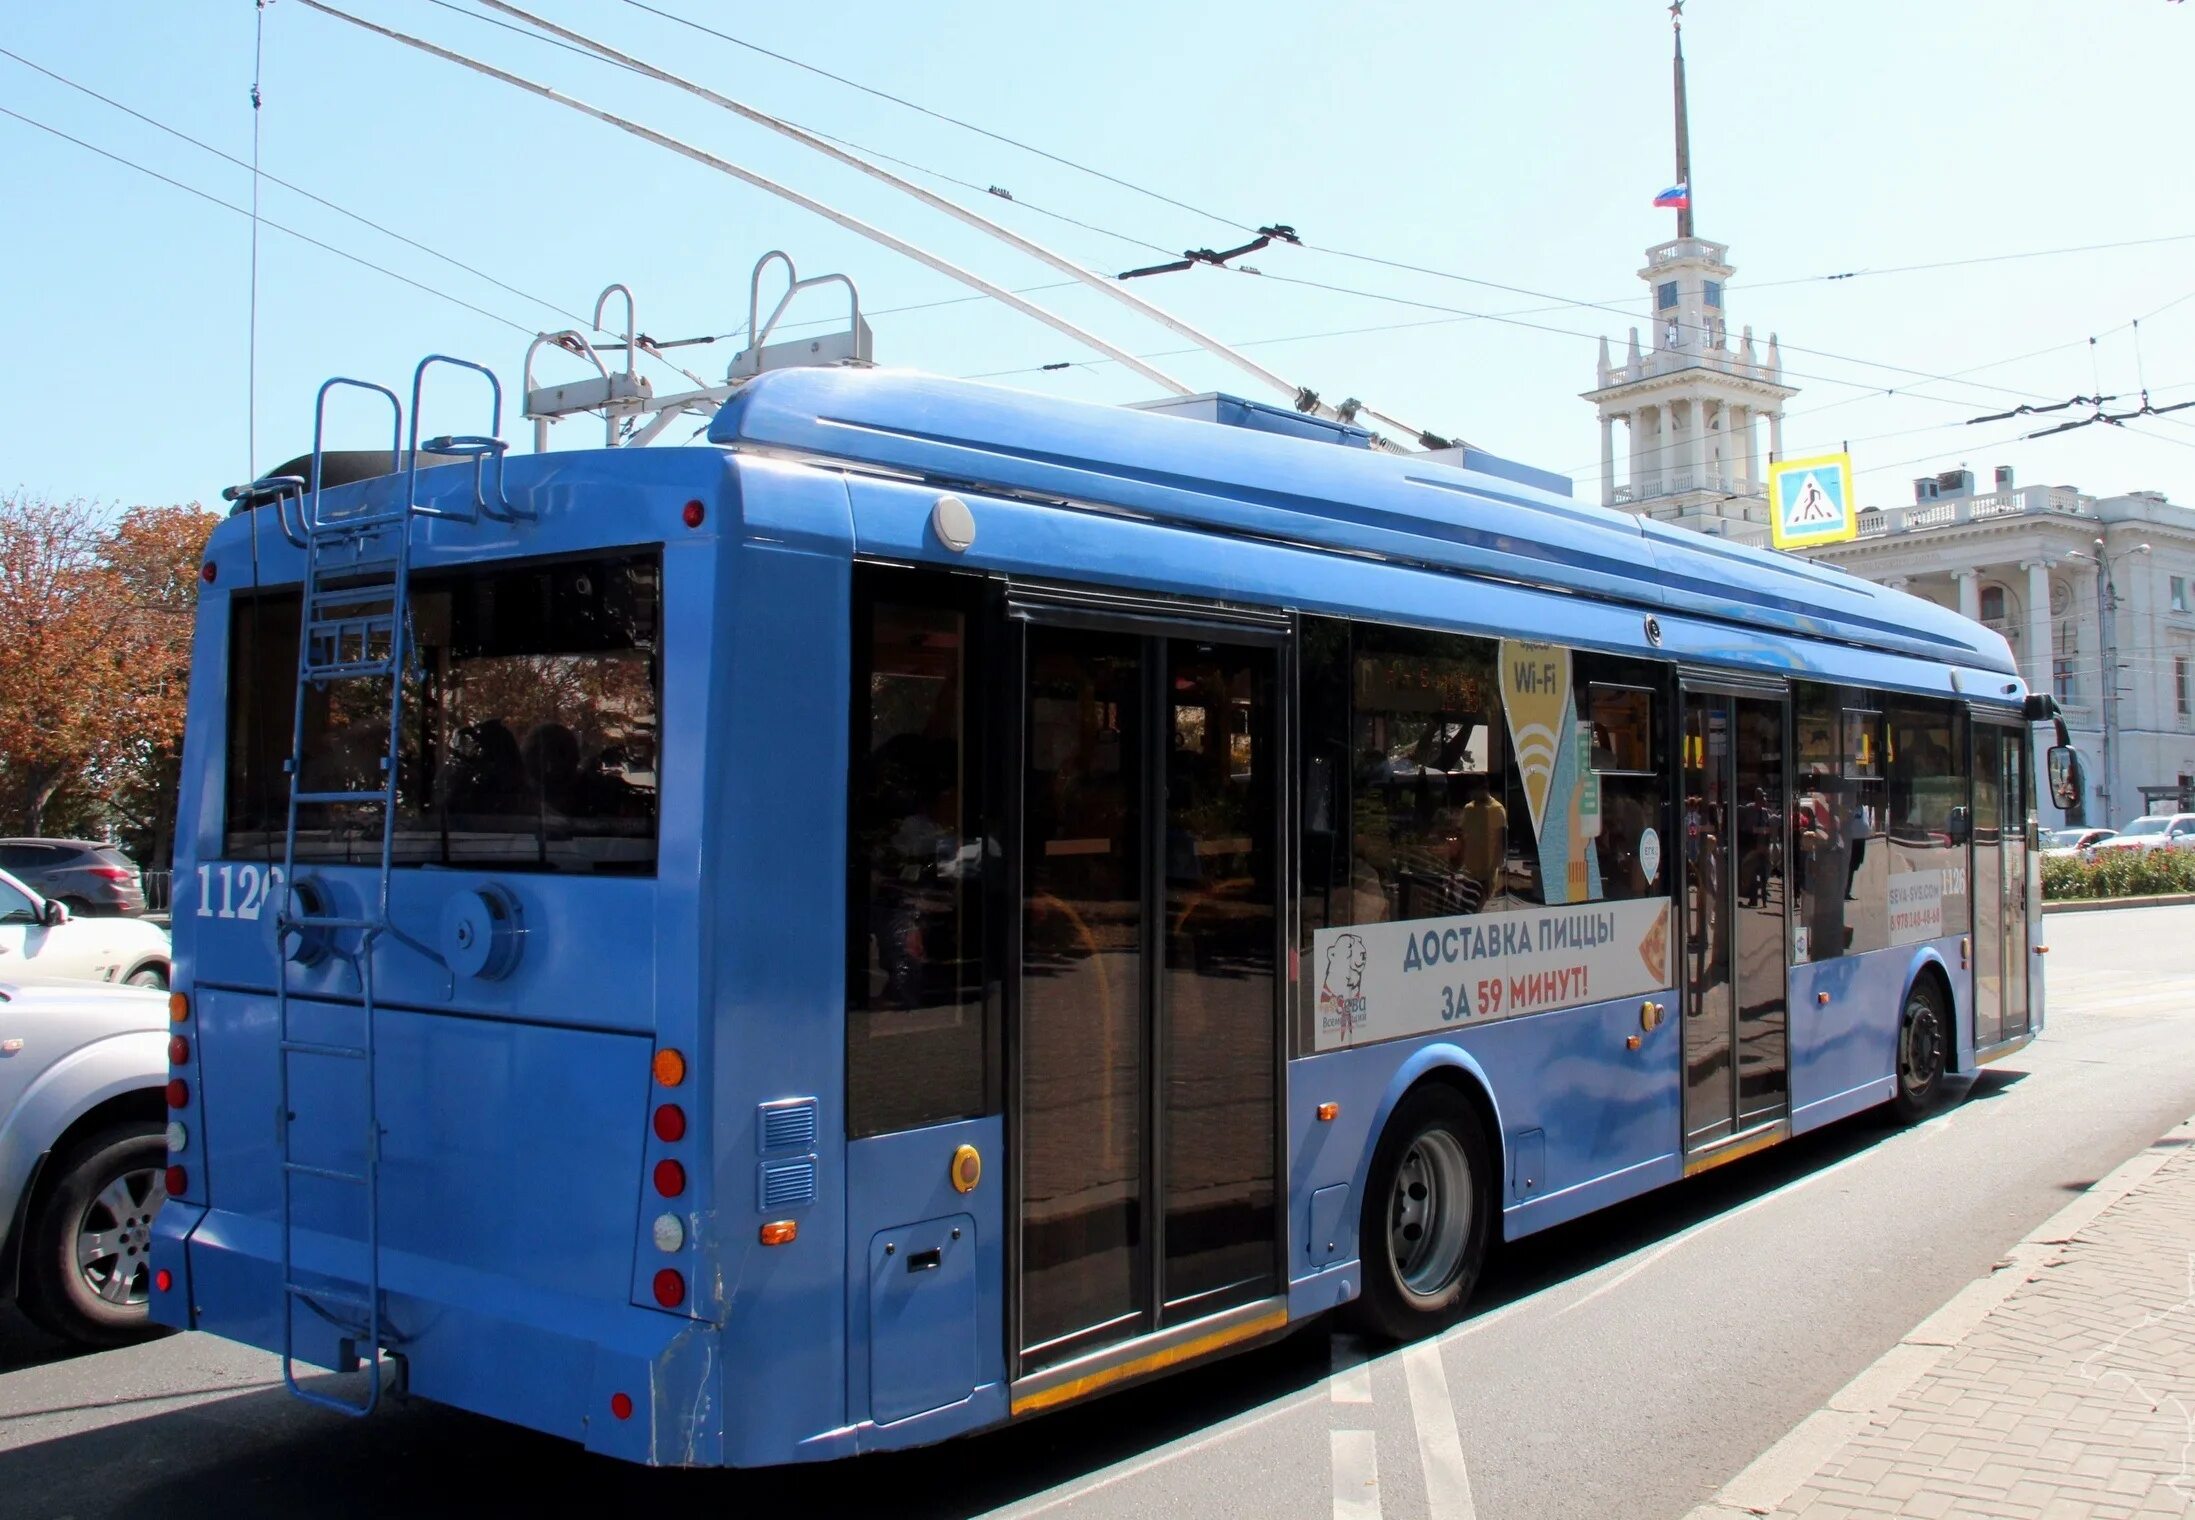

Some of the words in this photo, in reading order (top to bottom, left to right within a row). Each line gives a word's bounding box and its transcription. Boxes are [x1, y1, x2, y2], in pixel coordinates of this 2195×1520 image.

[1514, 660, 1556, 695] Wi-Fi
[1942, 868, 1966, 896] 1126
[1403, 921, 1532, 973] ДОСТАВКА
[1538, 911, 1615, 952] ПИЦЦЫ
[1441, 982, 1471, 1022] ЗА
[1477, 978, 1503, 1015] 59
[1509, 964, 1589, 1010] МИНУТ!
